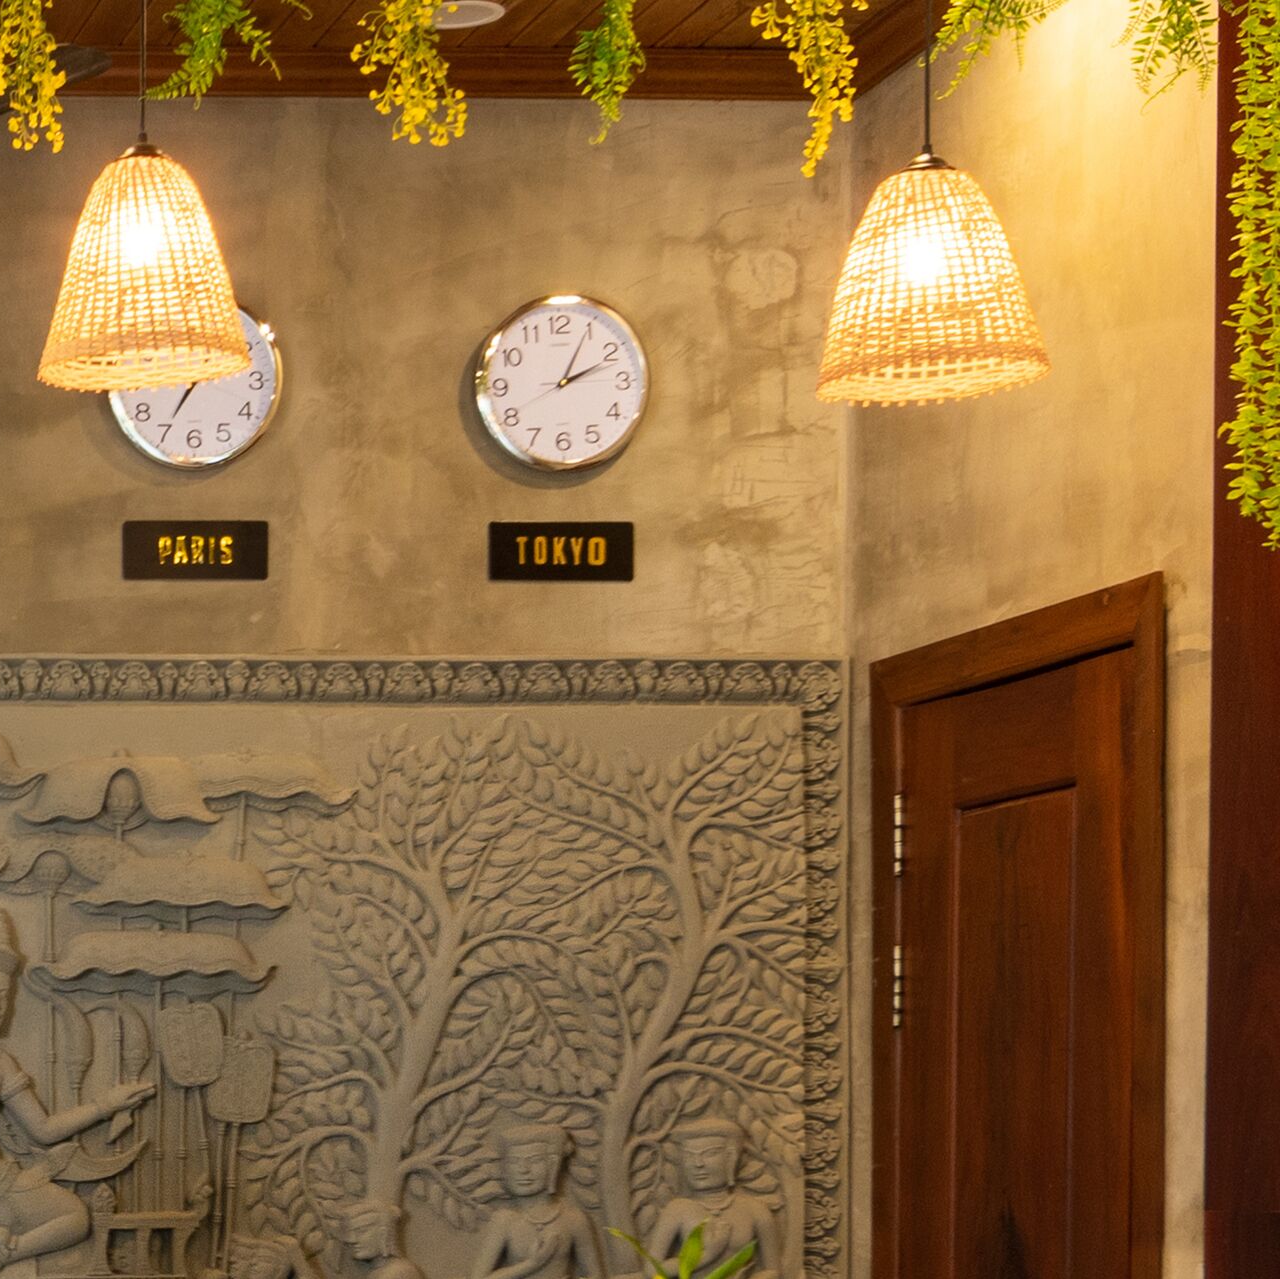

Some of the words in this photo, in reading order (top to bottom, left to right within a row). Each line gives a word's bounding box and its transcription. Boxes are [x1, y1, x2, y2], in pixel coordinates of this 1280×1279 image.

[522, 325, 539, 344] 11
[548, 315, 571, 335] 12
[502, 348, 522, 368] 10
[602, 342, 618, 362] 2
[248, 370, 264, 390] 3
[492, 378, 508, 398] 9
[616, 371, 630, 390] 3
[135, 402, 151, 422] 8
[238, 402, 253, 420] 4
[504, 408, 520, 427] 8
[606, 402, 620, 421] 4
[158, 424, 172, 443] 7
[186, 430, 202, 448] 6
[216, 423, 232, 442] 5
[526, 428, 542, 447] 7
[556, 432, 572, 451] 6
[584, 424, 600, 444] 5
[158, 535, 233, 564] PARIS
[516, 536, 607, 566] TOKYO
